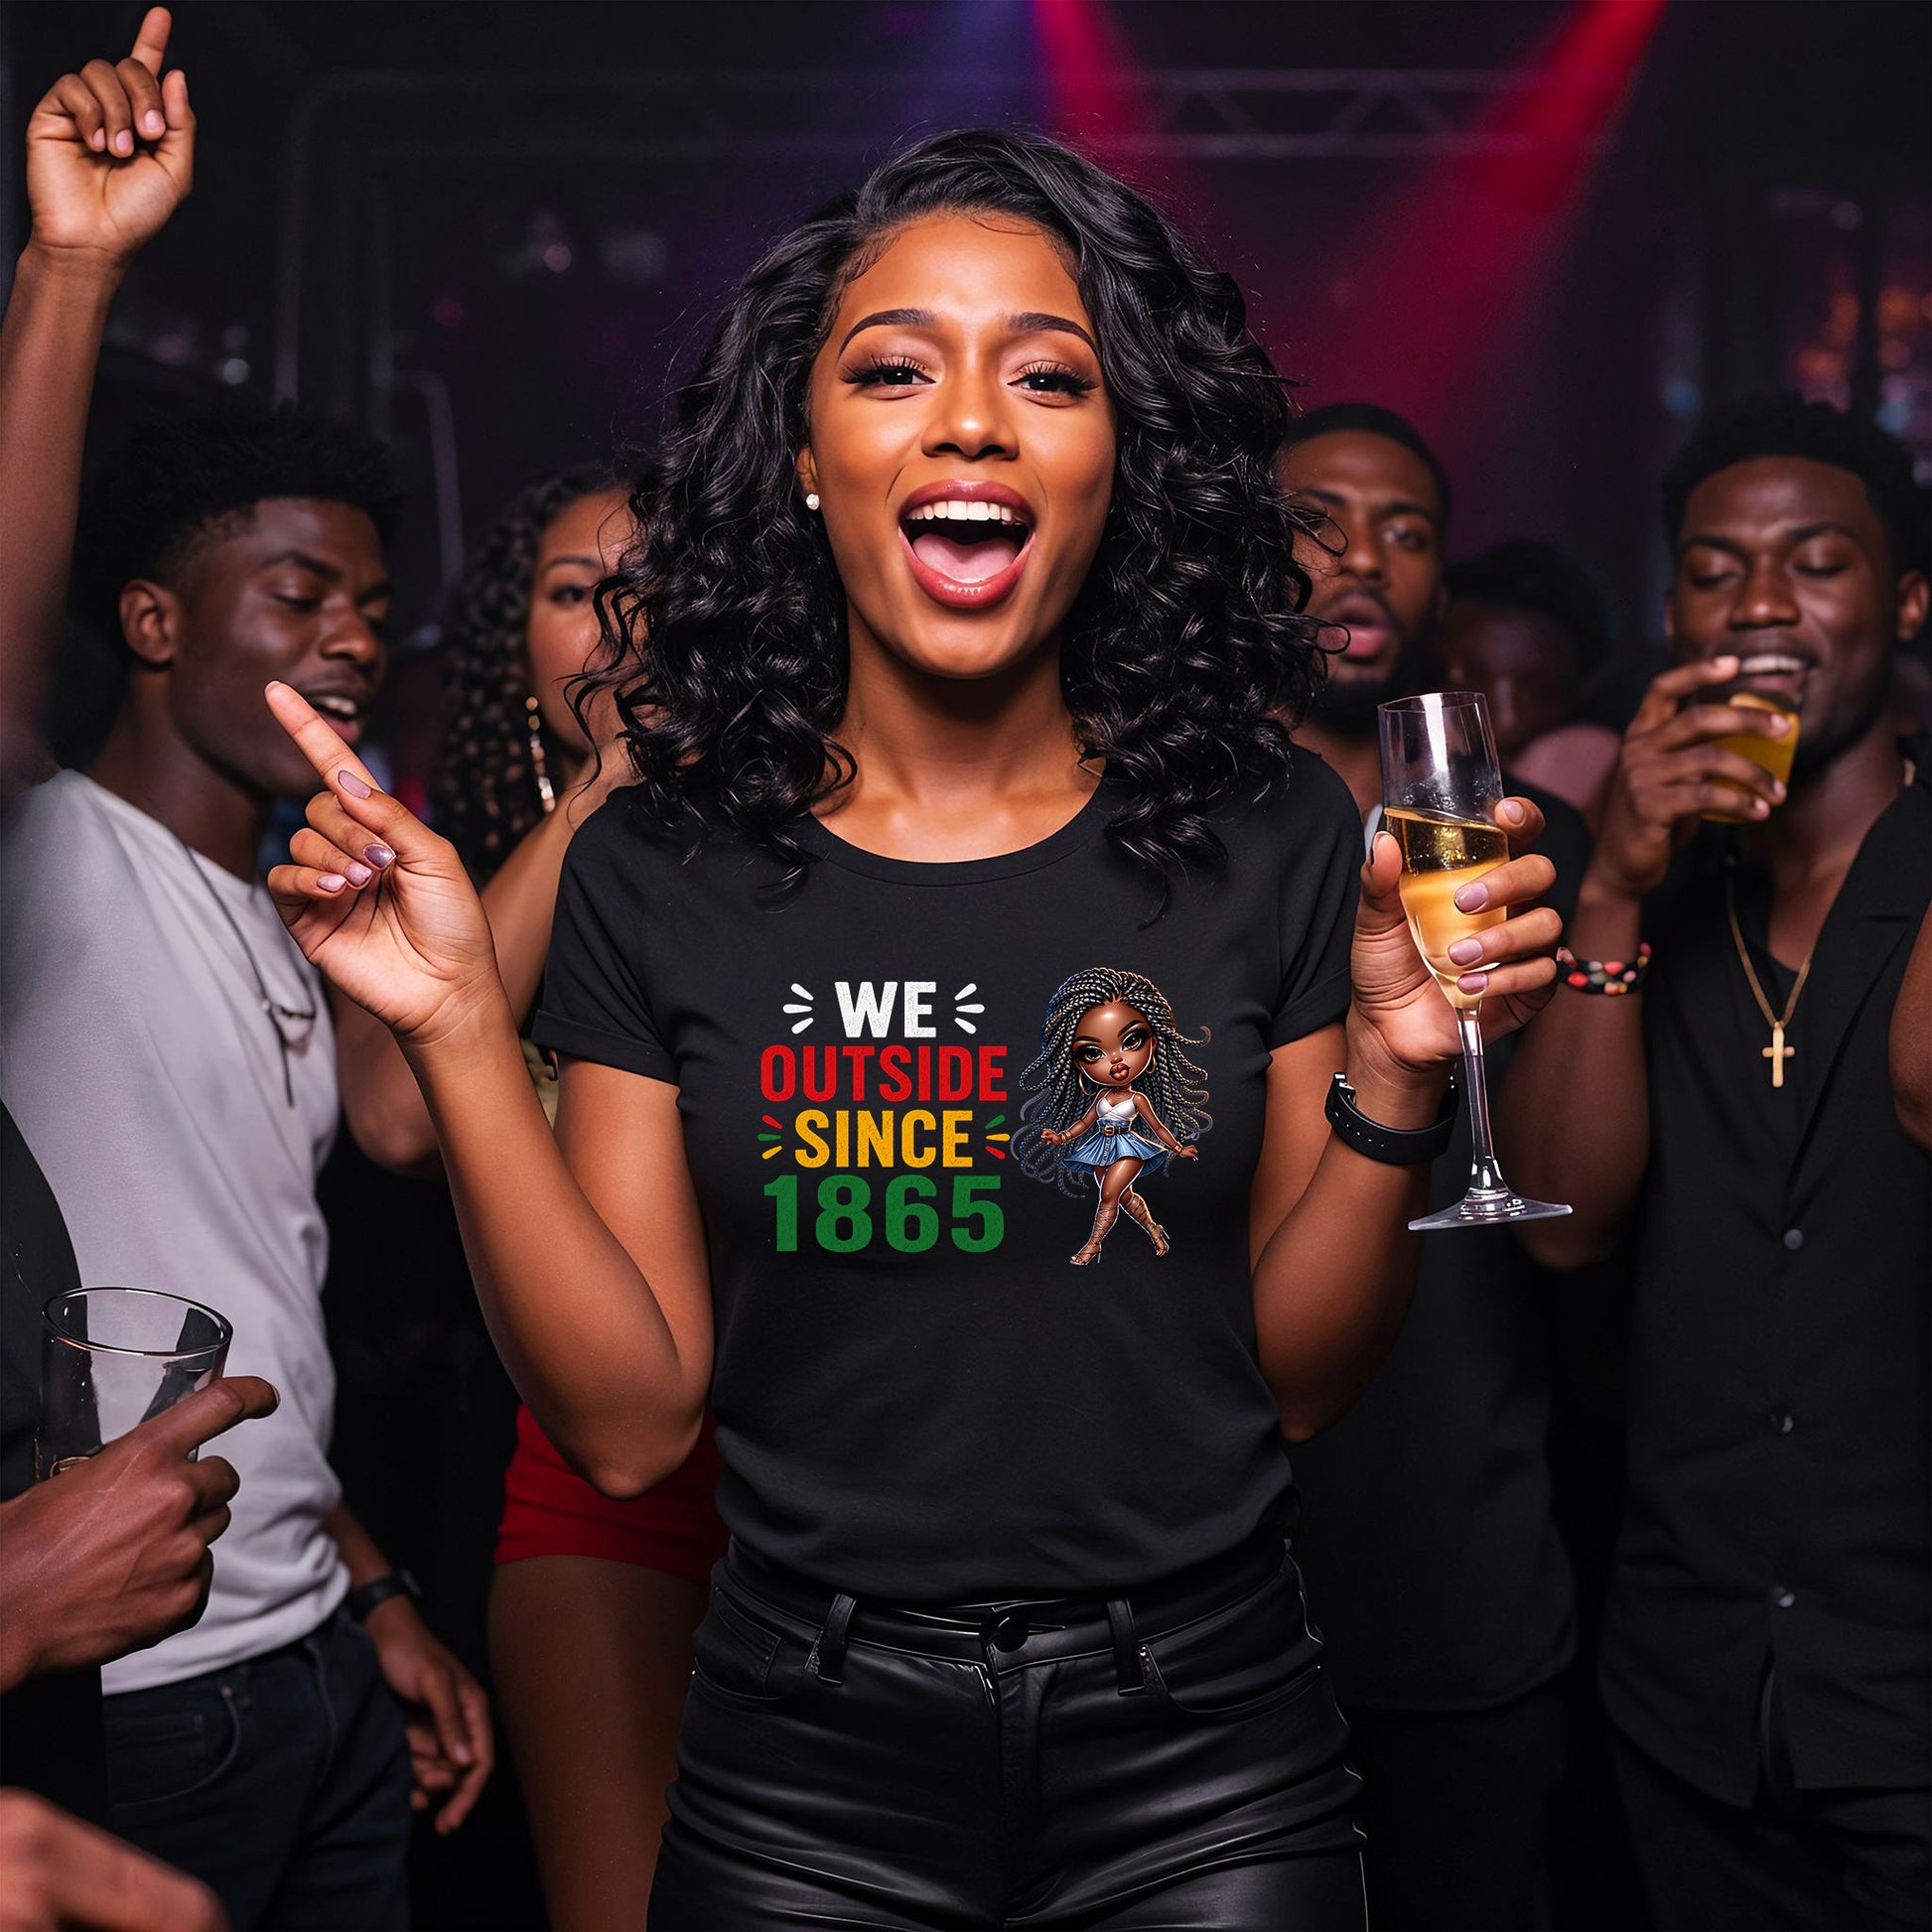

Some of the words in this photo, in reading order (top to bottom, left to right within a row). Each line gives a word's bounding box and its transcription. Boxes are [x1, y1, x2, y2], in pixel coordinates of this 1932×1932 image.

[834, 981, 937, 1038] WE
[759, 1044, 1008, 1102] OUTSIDE
[794, 1109, 974, 1169] SINCE
[763, 1174, 1005, 1253] 1865
